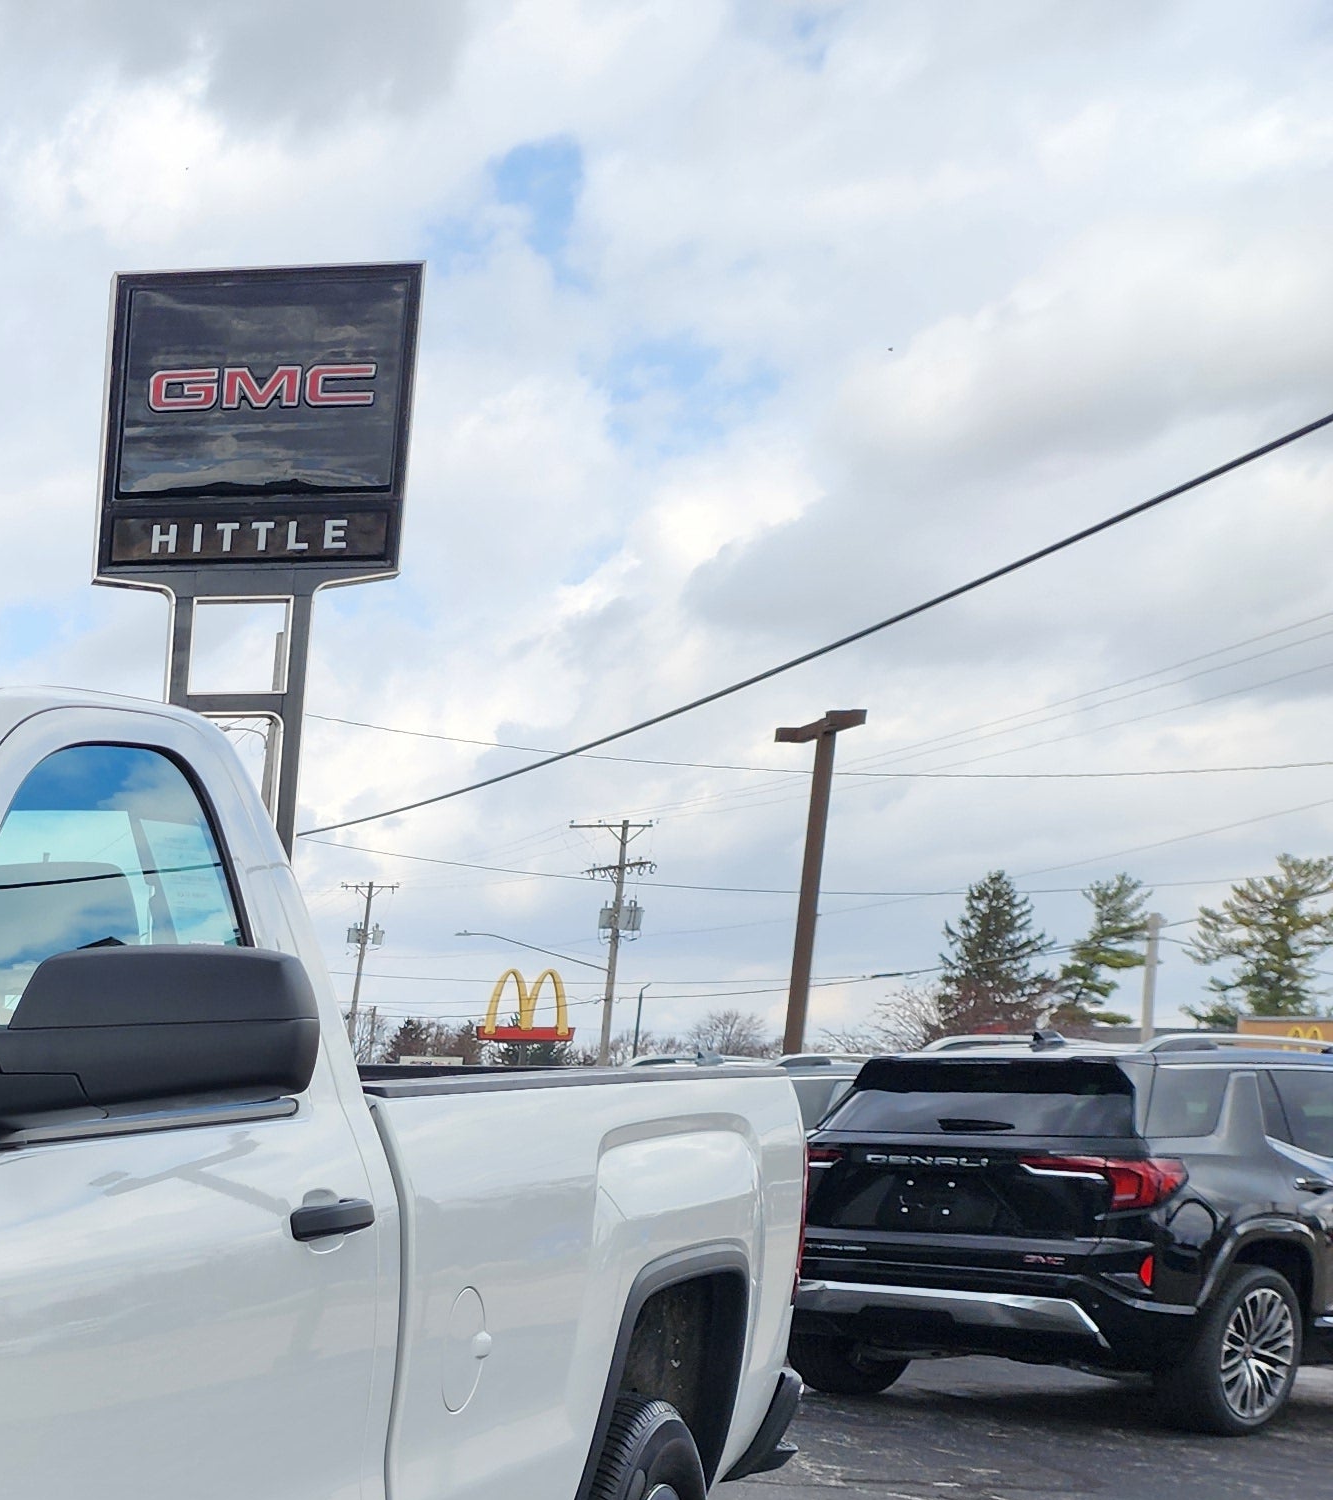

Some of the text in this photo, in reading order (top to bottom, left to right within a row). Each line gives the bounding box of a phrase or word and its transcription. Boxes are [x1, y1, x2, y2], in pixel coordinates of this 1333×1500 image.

[148, 363, 377, 411] GMC
[150, 519, 348, 554] HITTLE
[866, 1153, 988, 1168] DENALI
